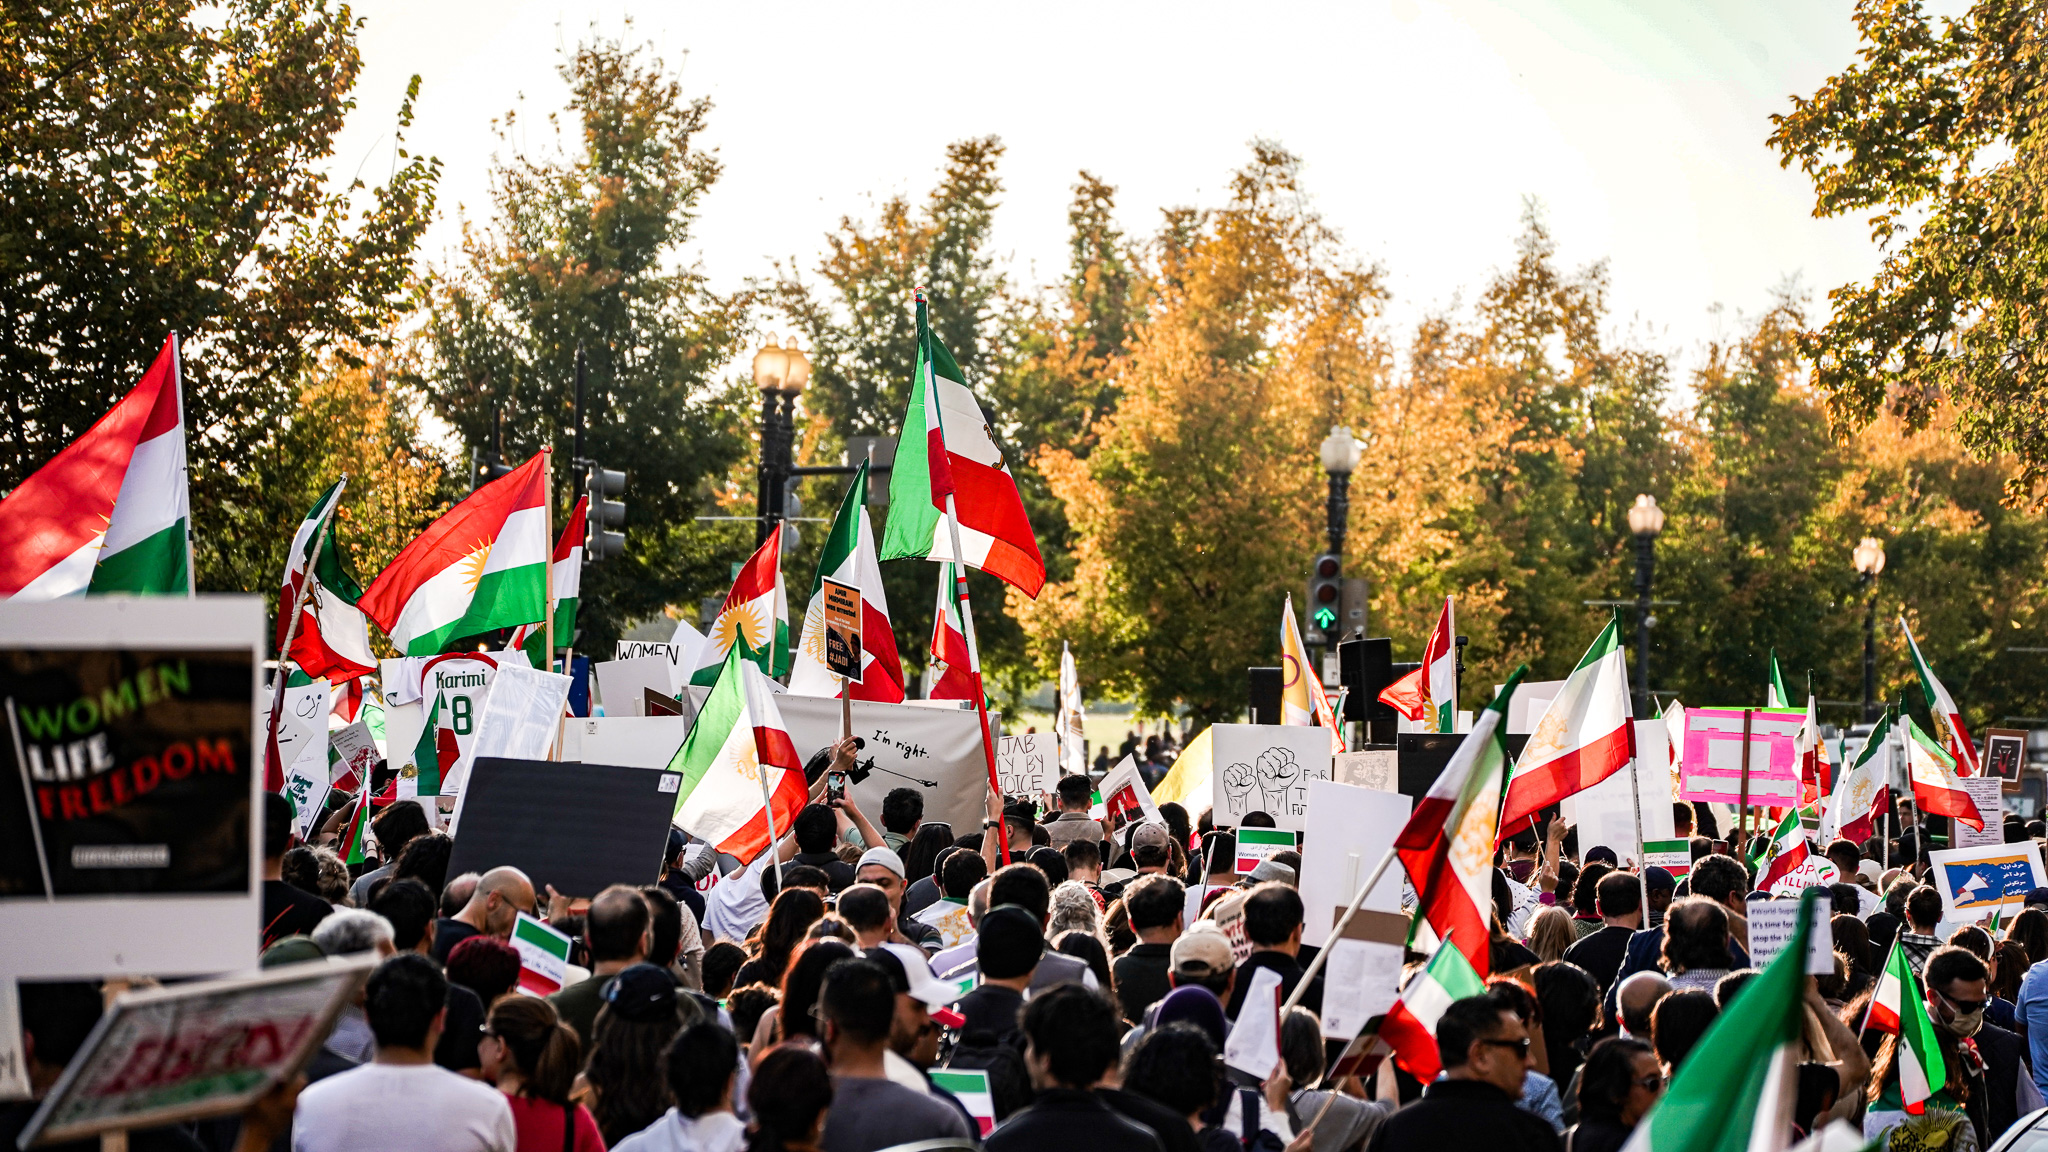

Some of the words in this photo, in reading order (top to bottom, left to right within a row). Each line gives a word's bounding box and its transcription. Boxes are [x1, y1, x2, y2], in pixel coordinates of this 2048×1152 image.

[618, 642, 679, 666] WOMEN
[828, 638, 844, 652] FREE
[829, 653, 848, 667] #JADI
[435, 668, 486, 689] Karimi
[19, 659, 191, 740] WOMEN
[452, 693, 473, 736] 8
[872, 729, 891, 746] I'm
[896, 741, 930, 759] right.
[998, 734, 1036, 757] JAB
[28, 732, 115, 781] LIFE
[998, 757, 1014, 775] LY
[1026, 754, 1044, 774] BY
[37, 737, 237, 820] FREEDOM
[999, 774, 1043, 794] OICE
[1796, 864, 1815, 876] OP
[1752, 921, 1763, 929] It's
[1765, 921, 1780, 929] time
[1783, 920, 1793, 929] for
[1753, 935, 1768, 943] stop
